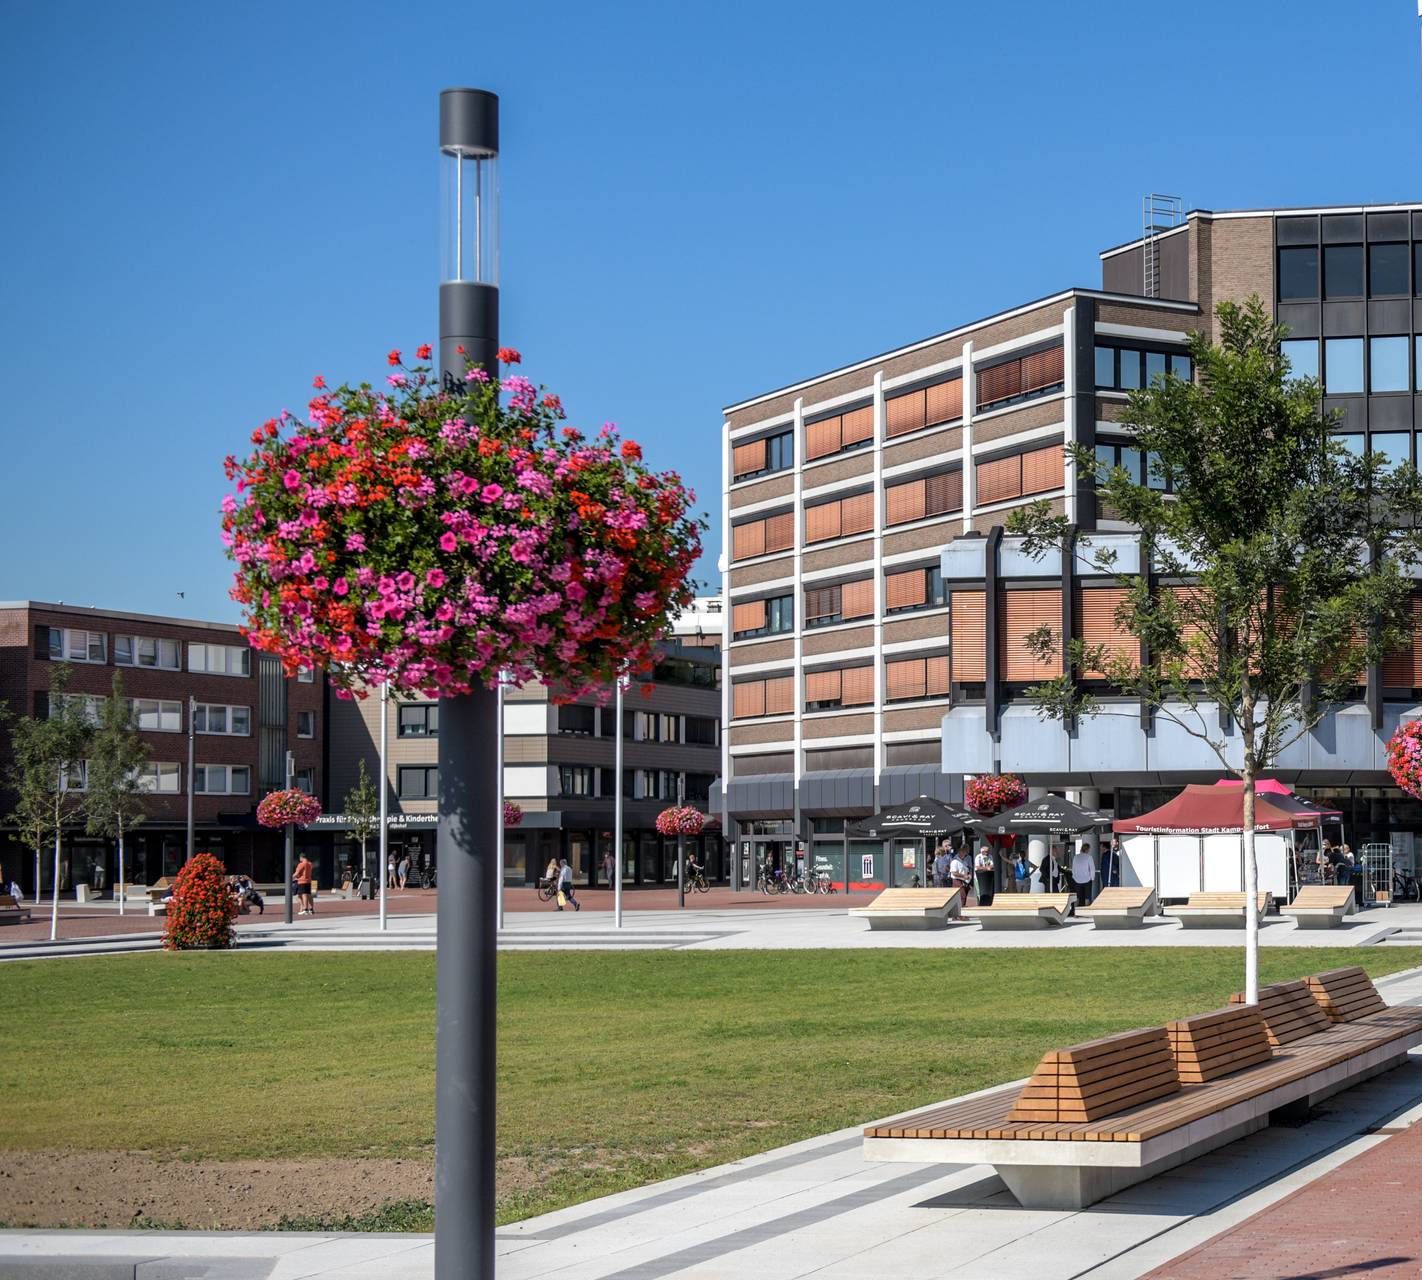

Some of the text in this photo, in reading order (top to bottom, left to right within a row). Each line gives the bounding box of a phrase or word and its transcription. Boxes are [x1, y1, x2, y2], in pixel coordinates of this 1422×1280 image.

[315, 816, 335, 824] Praxis
[1135, 825, 1200, 834] Touristinformation
[1201, 826, 1220, 834] Stadt
